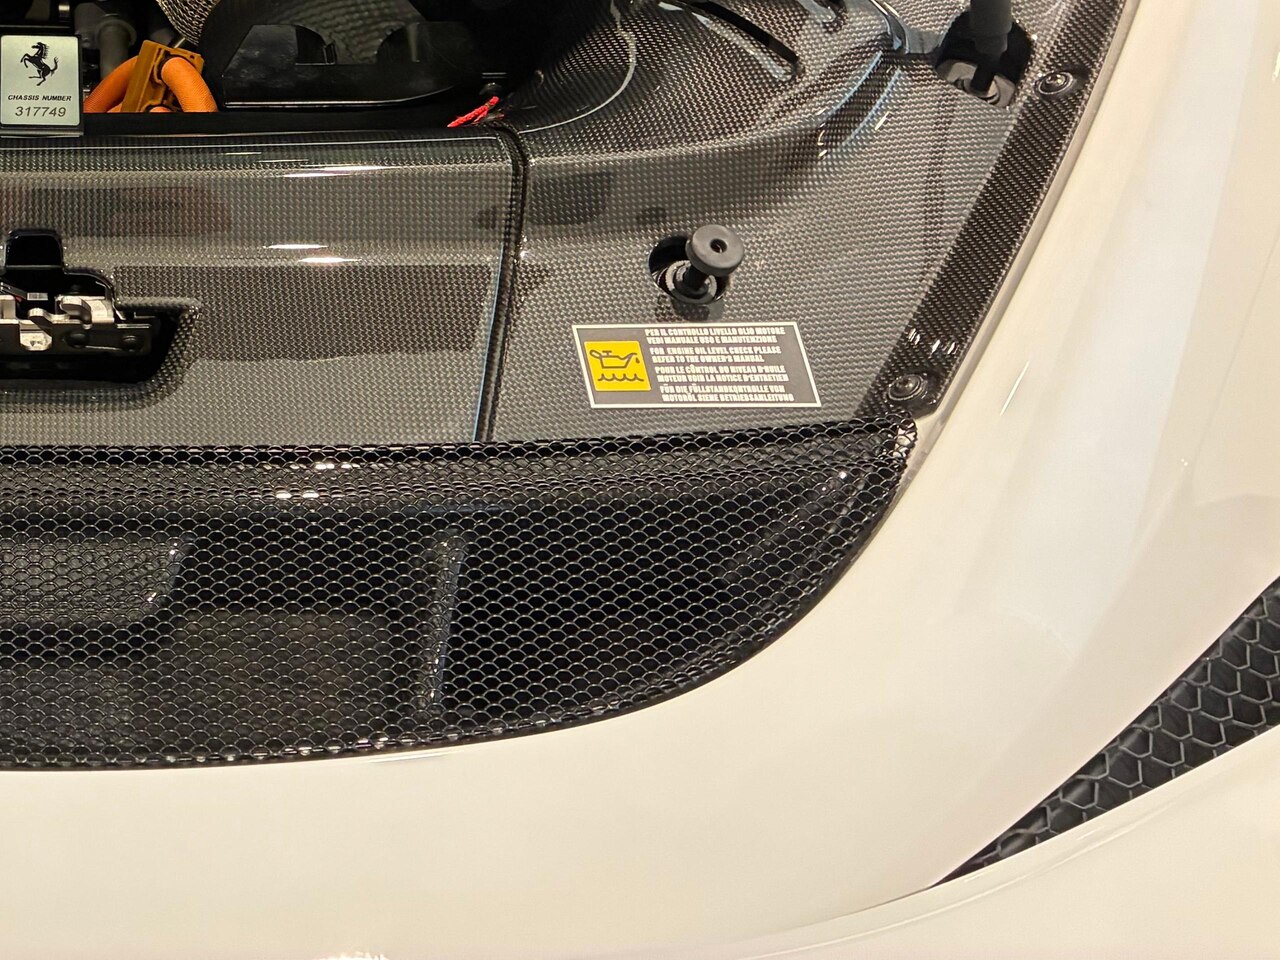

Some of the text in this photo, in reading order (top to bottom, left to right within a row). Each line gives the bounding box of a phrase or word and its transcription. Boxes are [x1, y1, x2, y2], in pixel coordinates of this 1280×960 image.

[15, 106, 67, 117] 317749
[649, 347, 665, 355] FOR
[729, 346, 754, 354] CHECK
[753, 346, 782, 354] PLEASE
[652, 355, 676, 363] REFER
[675, 355, 686, 363] TO
[685, 355, 700, 363] THE
